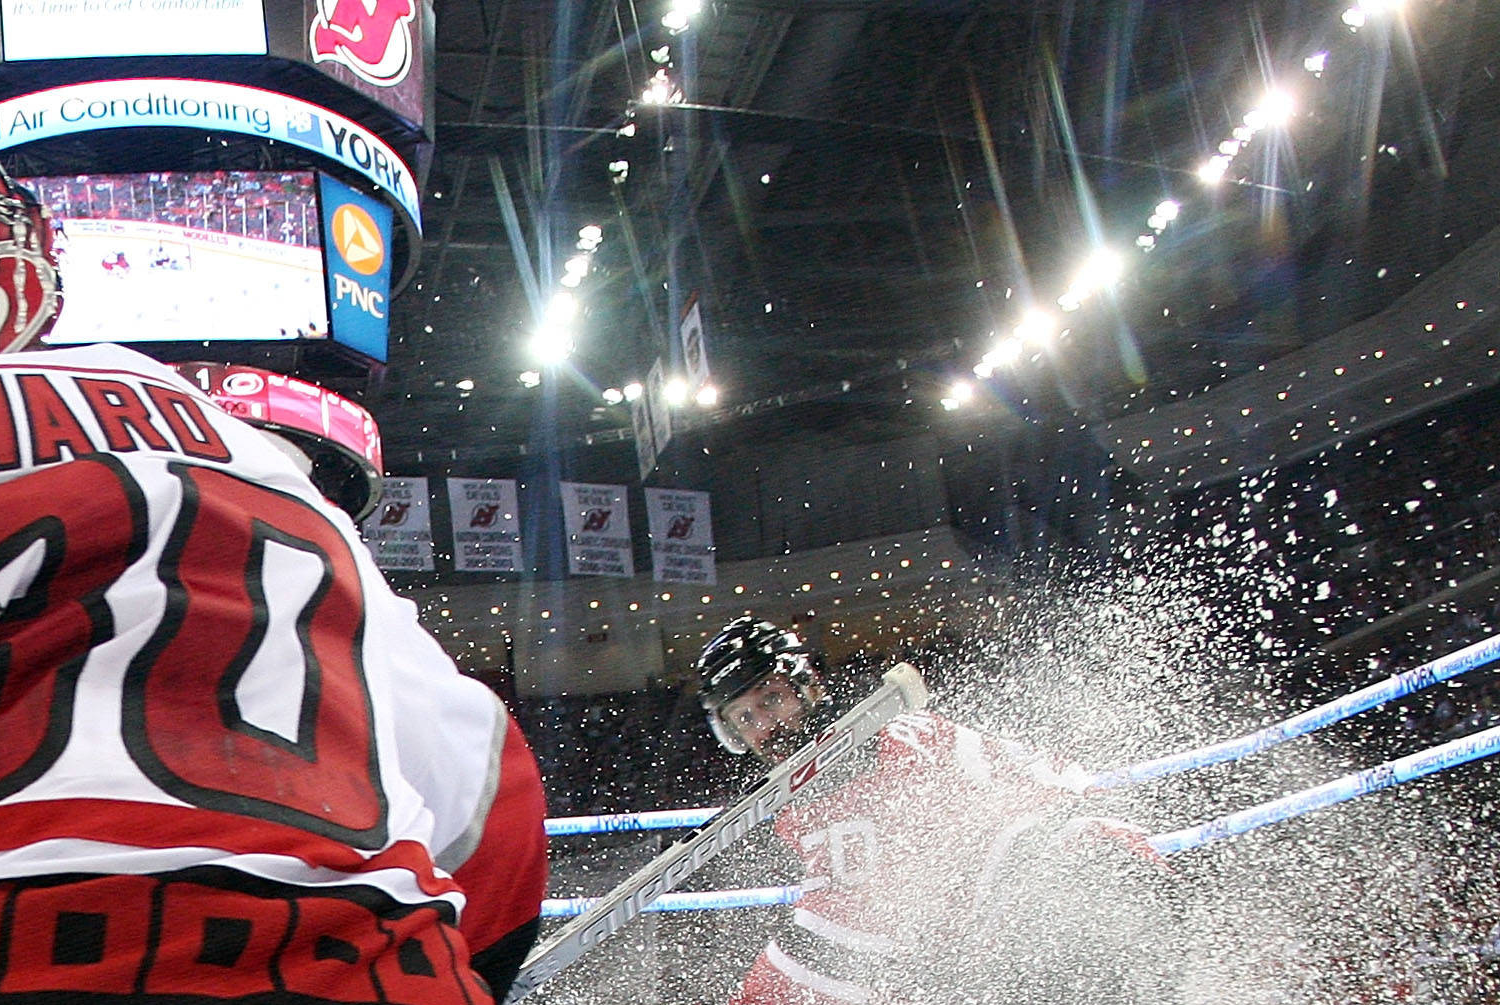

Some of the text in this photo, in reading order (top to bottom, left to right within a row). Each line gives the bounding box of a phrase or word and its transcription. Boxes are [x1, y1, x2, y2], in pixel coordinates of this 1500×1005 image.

[9, 105, 50, 138] Air
[60, 93, 271, 133] Conditioning
[324, 119, 407, 200] YORK
[333, 273, 385, 318] PNC
[604, 814, 642, 831] YORK
